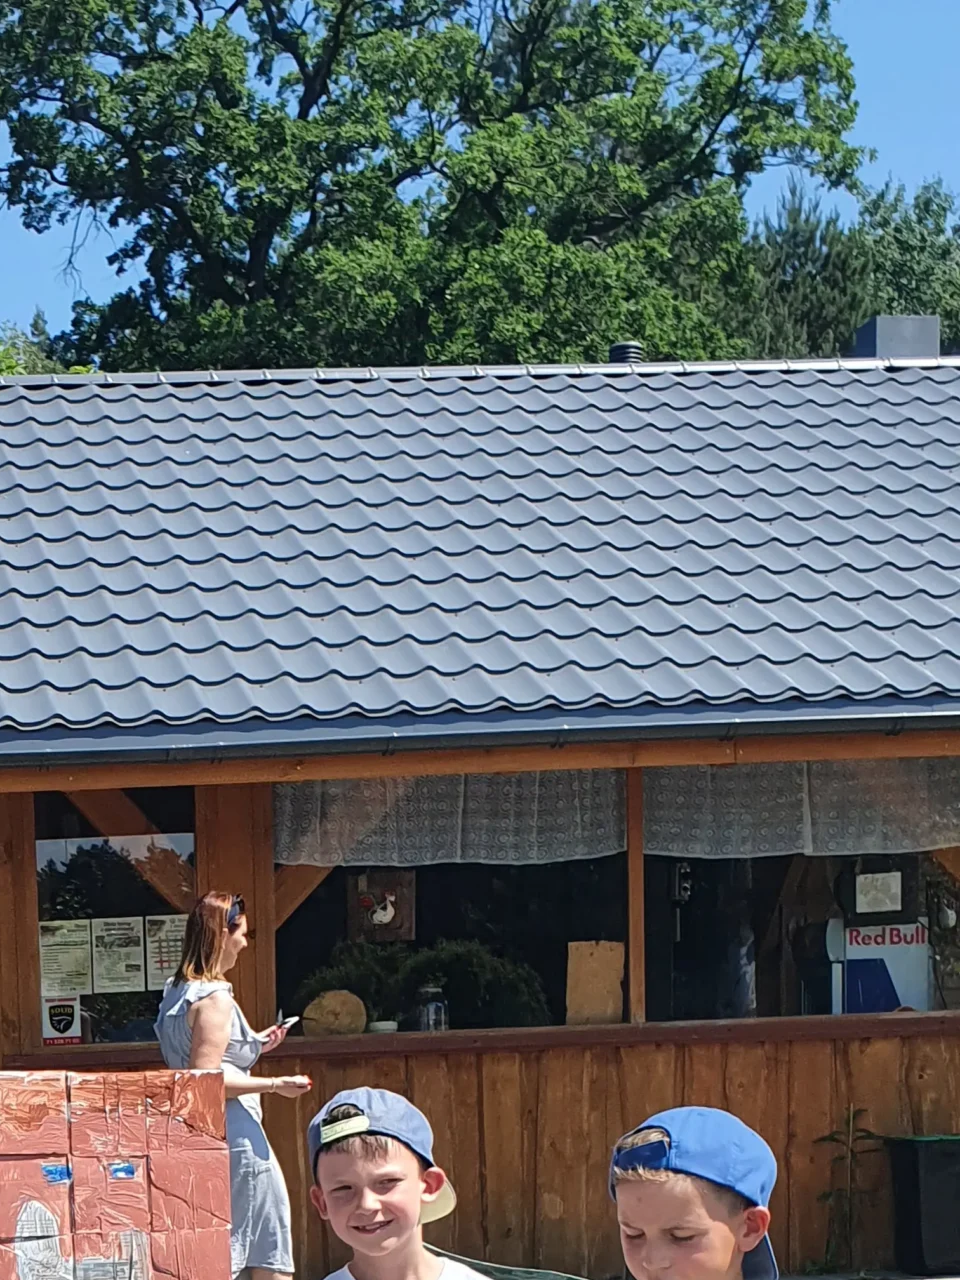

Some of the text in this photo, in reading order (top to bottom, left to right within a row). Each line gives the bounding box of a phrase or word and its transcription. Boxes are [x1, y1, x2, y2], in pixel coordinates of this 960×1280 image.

[848, 925, 926, 946] Red Bull
[50, 1007, 73, 1015] SOLID
